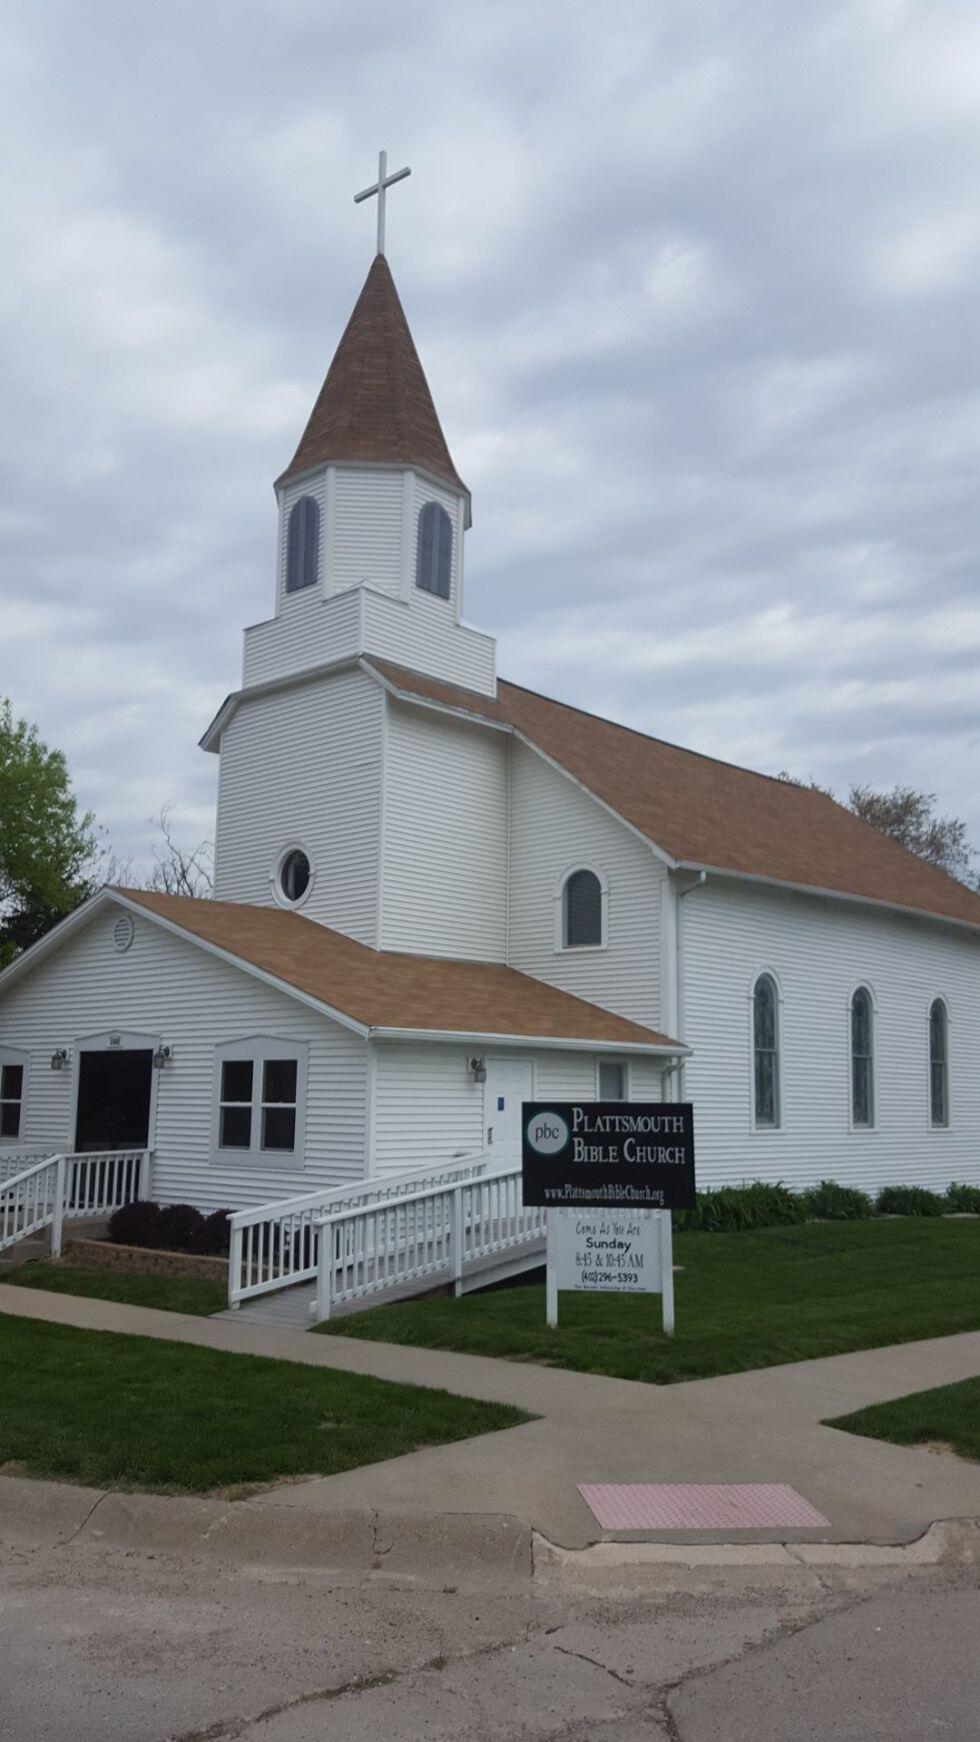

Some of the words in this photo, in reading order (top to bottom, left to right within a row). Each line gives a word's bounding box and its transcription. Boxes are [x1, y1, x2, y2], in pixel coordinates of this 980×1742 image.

[572, 1107, 685, 1133] PLATTSMOUTH
[534, 1122, 560, 1143] pbc
[572, 1137, 620, 1163] BIBLE
[623, 1137, 686, 1164] CHURCH
[585, 1236, 632, 1254] Sunday
[595, 1253, 603, 1267] &
[627, 1253, 644, 1269] AM
